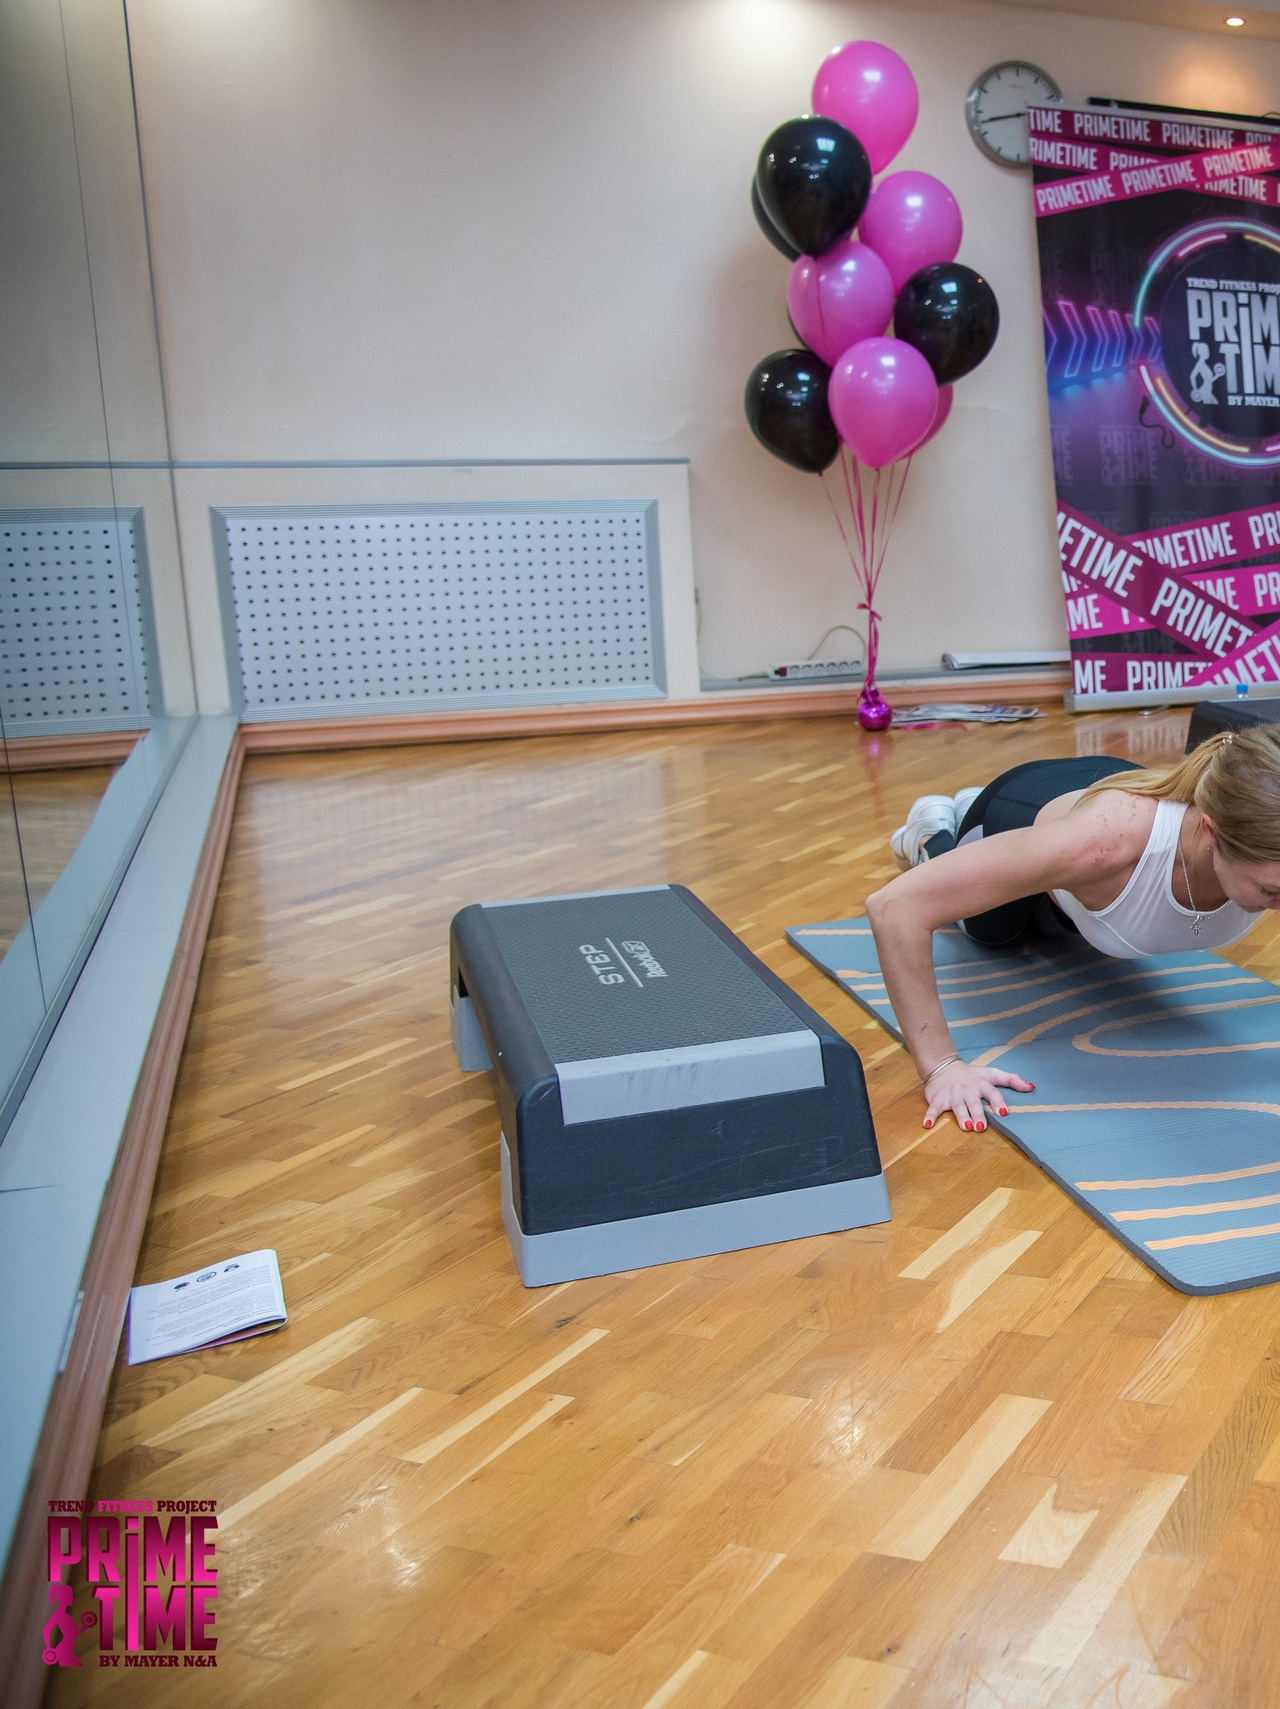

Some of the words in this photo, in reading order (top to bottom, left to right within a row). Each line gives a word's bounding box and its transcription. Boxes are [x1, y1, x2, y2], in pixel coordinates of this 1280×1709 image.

[1074, 113, 1151, 142] PRIMETIME
[1036, 175, 1115, 213] PRIMETIME
[1120, 159, 1197, 195] PRIMETIME
[1203, 145, 1274, 179] PRIMETIME
[1187, 277, 1219, 290] TREND
[1219, 280, 1258, 292] FITNESS
[1227, 395, 1244, 406] BY
[1245, 396, 1280, 407] MAYER
[579, 944, 626, 985] STEP
